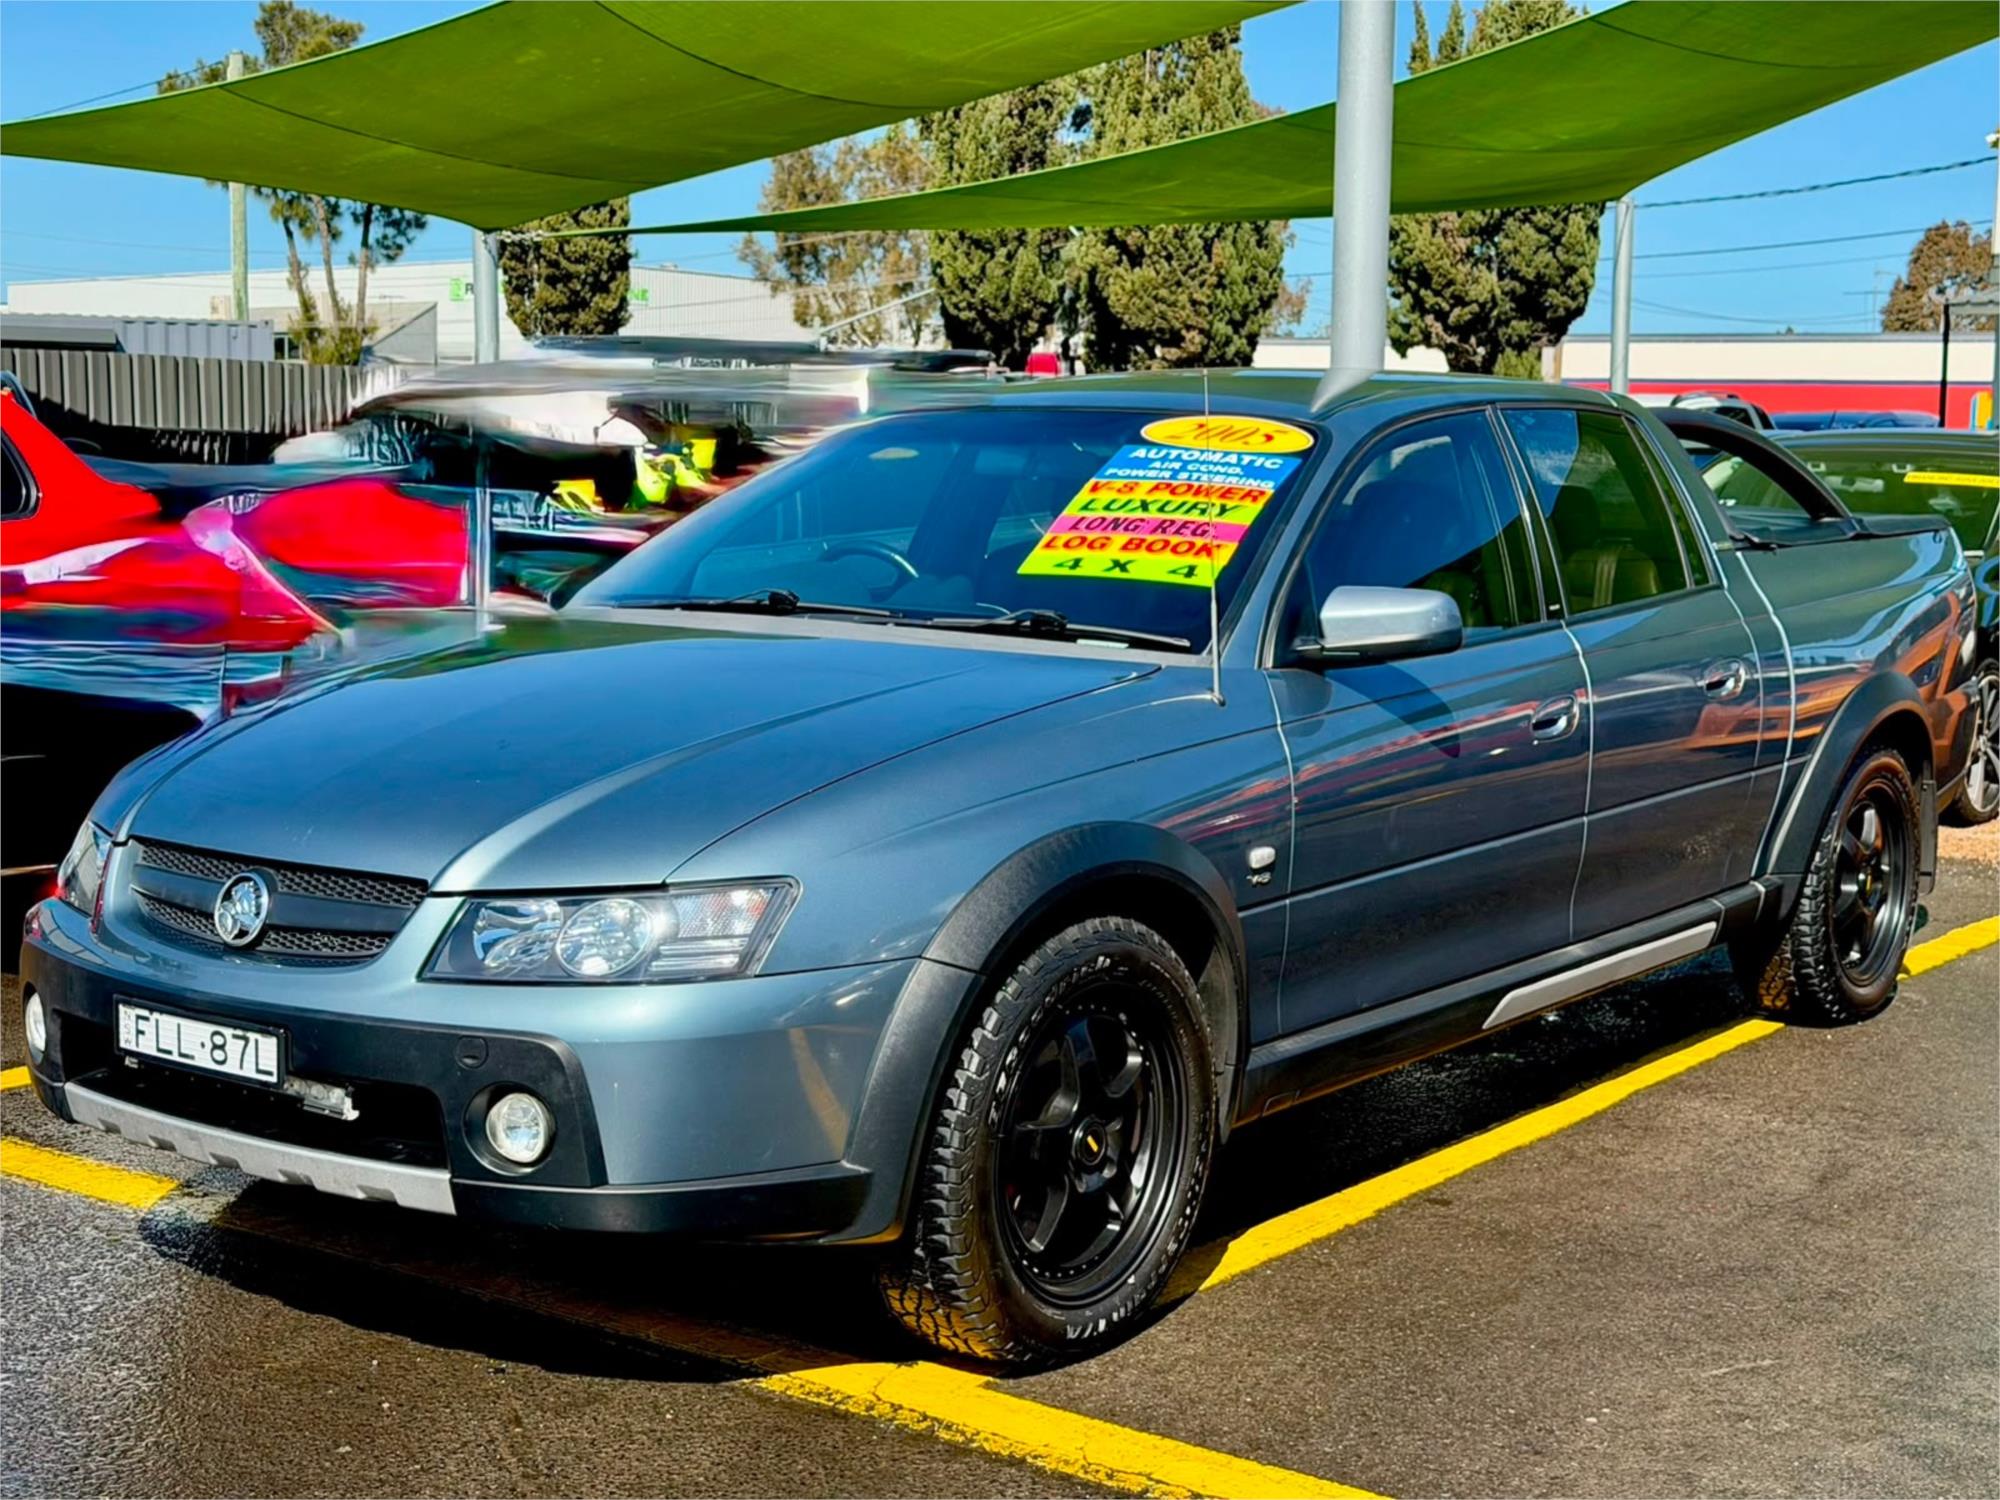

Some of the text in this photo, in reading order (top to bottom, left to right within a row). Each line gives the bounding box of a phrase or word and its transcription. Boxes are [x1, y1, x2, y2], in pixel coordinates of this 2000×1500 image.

[1164, 422, 1289, 446] 2005
[1129, 447, 1285, 470] AUTOMATIC
[1148, 461, 1244, 476] AIR COND.
[1104, 467, 1276, 489] POWER STEERING
[1088, 480, 1266, 502] V-8 POWER
[1079, 498, 1242, 517] LUXURY
[1068, 516, 1146, 532] LONG
[1042, 535, 1223, 558] LOG BOOK
[1053, 557, 1199, 578] 4 X 4
